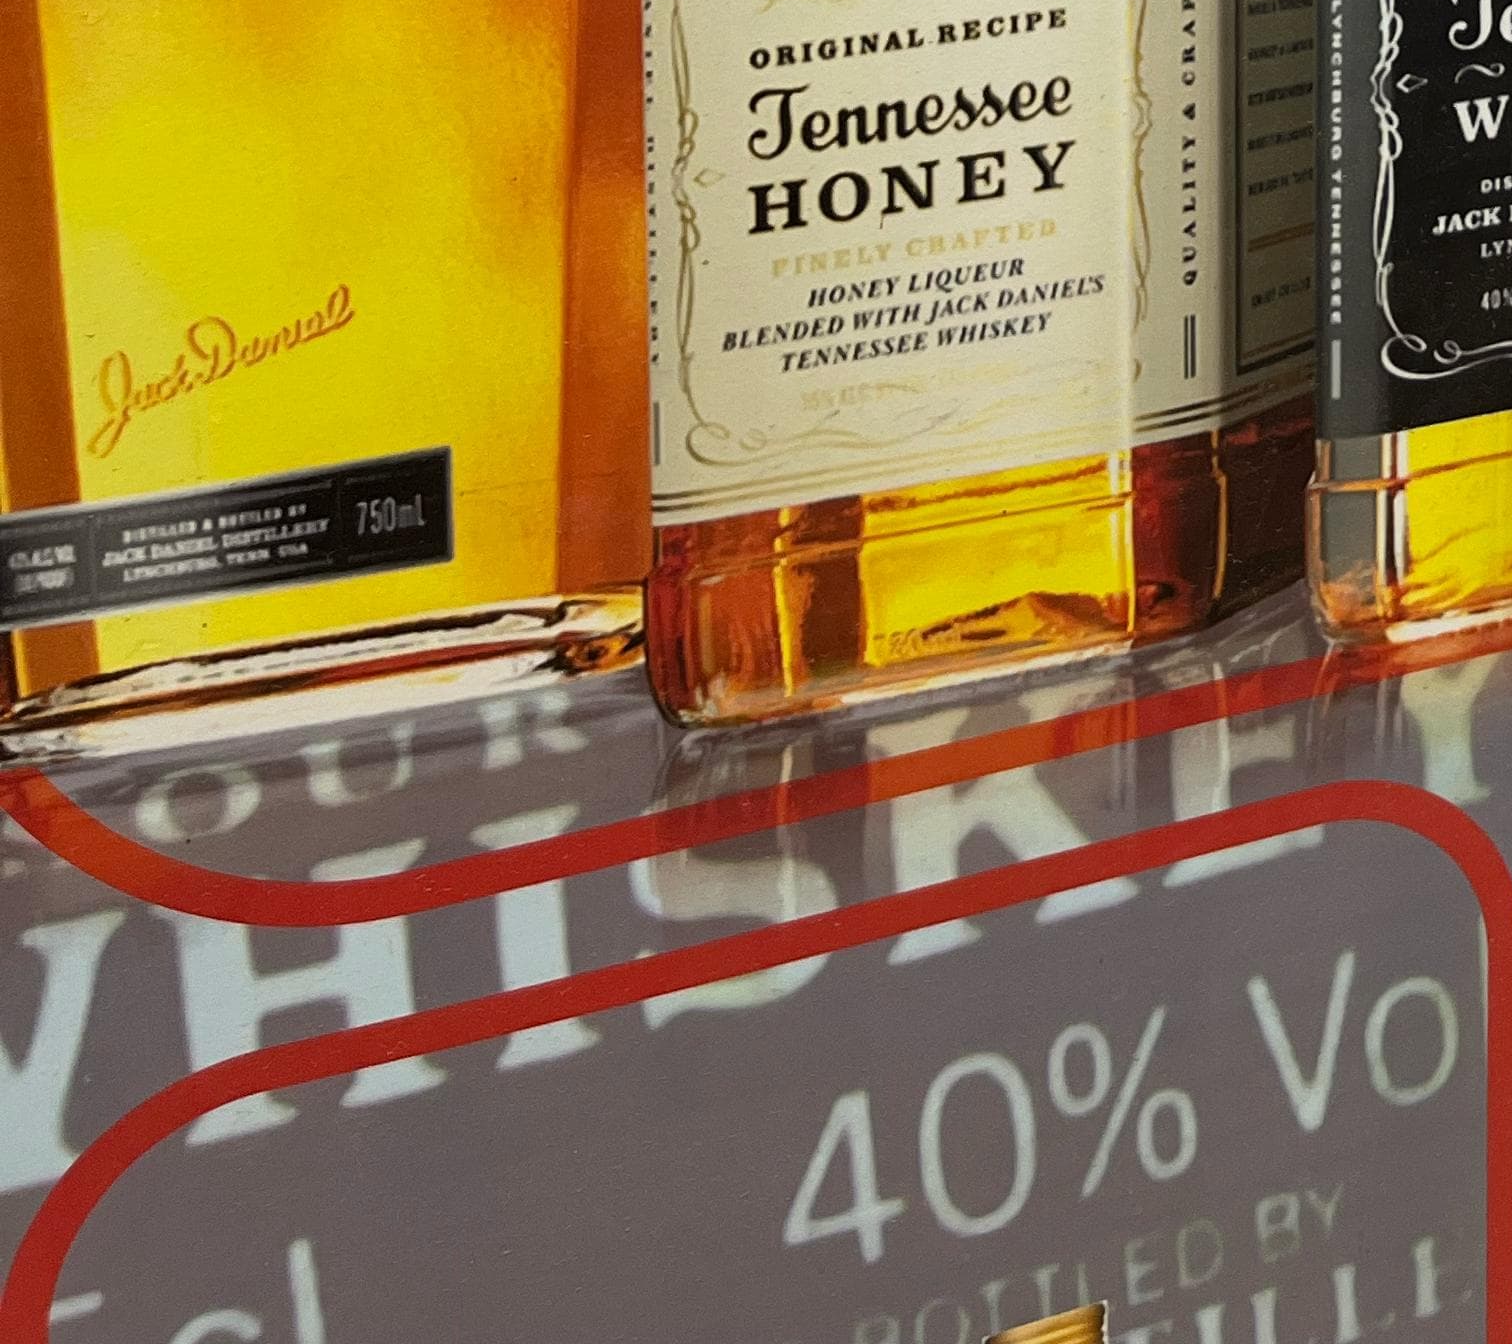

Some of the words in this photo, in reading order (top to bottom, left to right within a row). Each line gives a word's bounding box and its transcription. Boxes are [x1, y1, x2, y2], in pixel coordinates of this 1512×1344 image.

[748, 27, 926, 70] ORIGINAL
[937, 7, 1069, 45] RECIPE
[747, 74, 1074, 161] Tennessee
[747, 139, 1077, 236] HONEY
[1181, 134, 1198, 287] QUALITY
[1432, 206, 1502, 236] JACK
[770, 241, 895, 279] FINELY
[904, 216, 1060, 259] CRAFTED
[806, 275, 901, 309] HONEY
[907, 257, 1026, 293] LIQUEUR
[720, 315, 845, 353] BLENDED
[852, 299, 921, 331] WITH
[924, 291, 989, 326] JACK
[995, 274, 1107, 310] DANIEL'S
[779, 331, 929, 374] TENNESSEE
[936, 311, 1053, 348] WHISKEY
[784, 1004, 1197, 1265] 40%
[1255, 1183, 1345, 1261] BY
